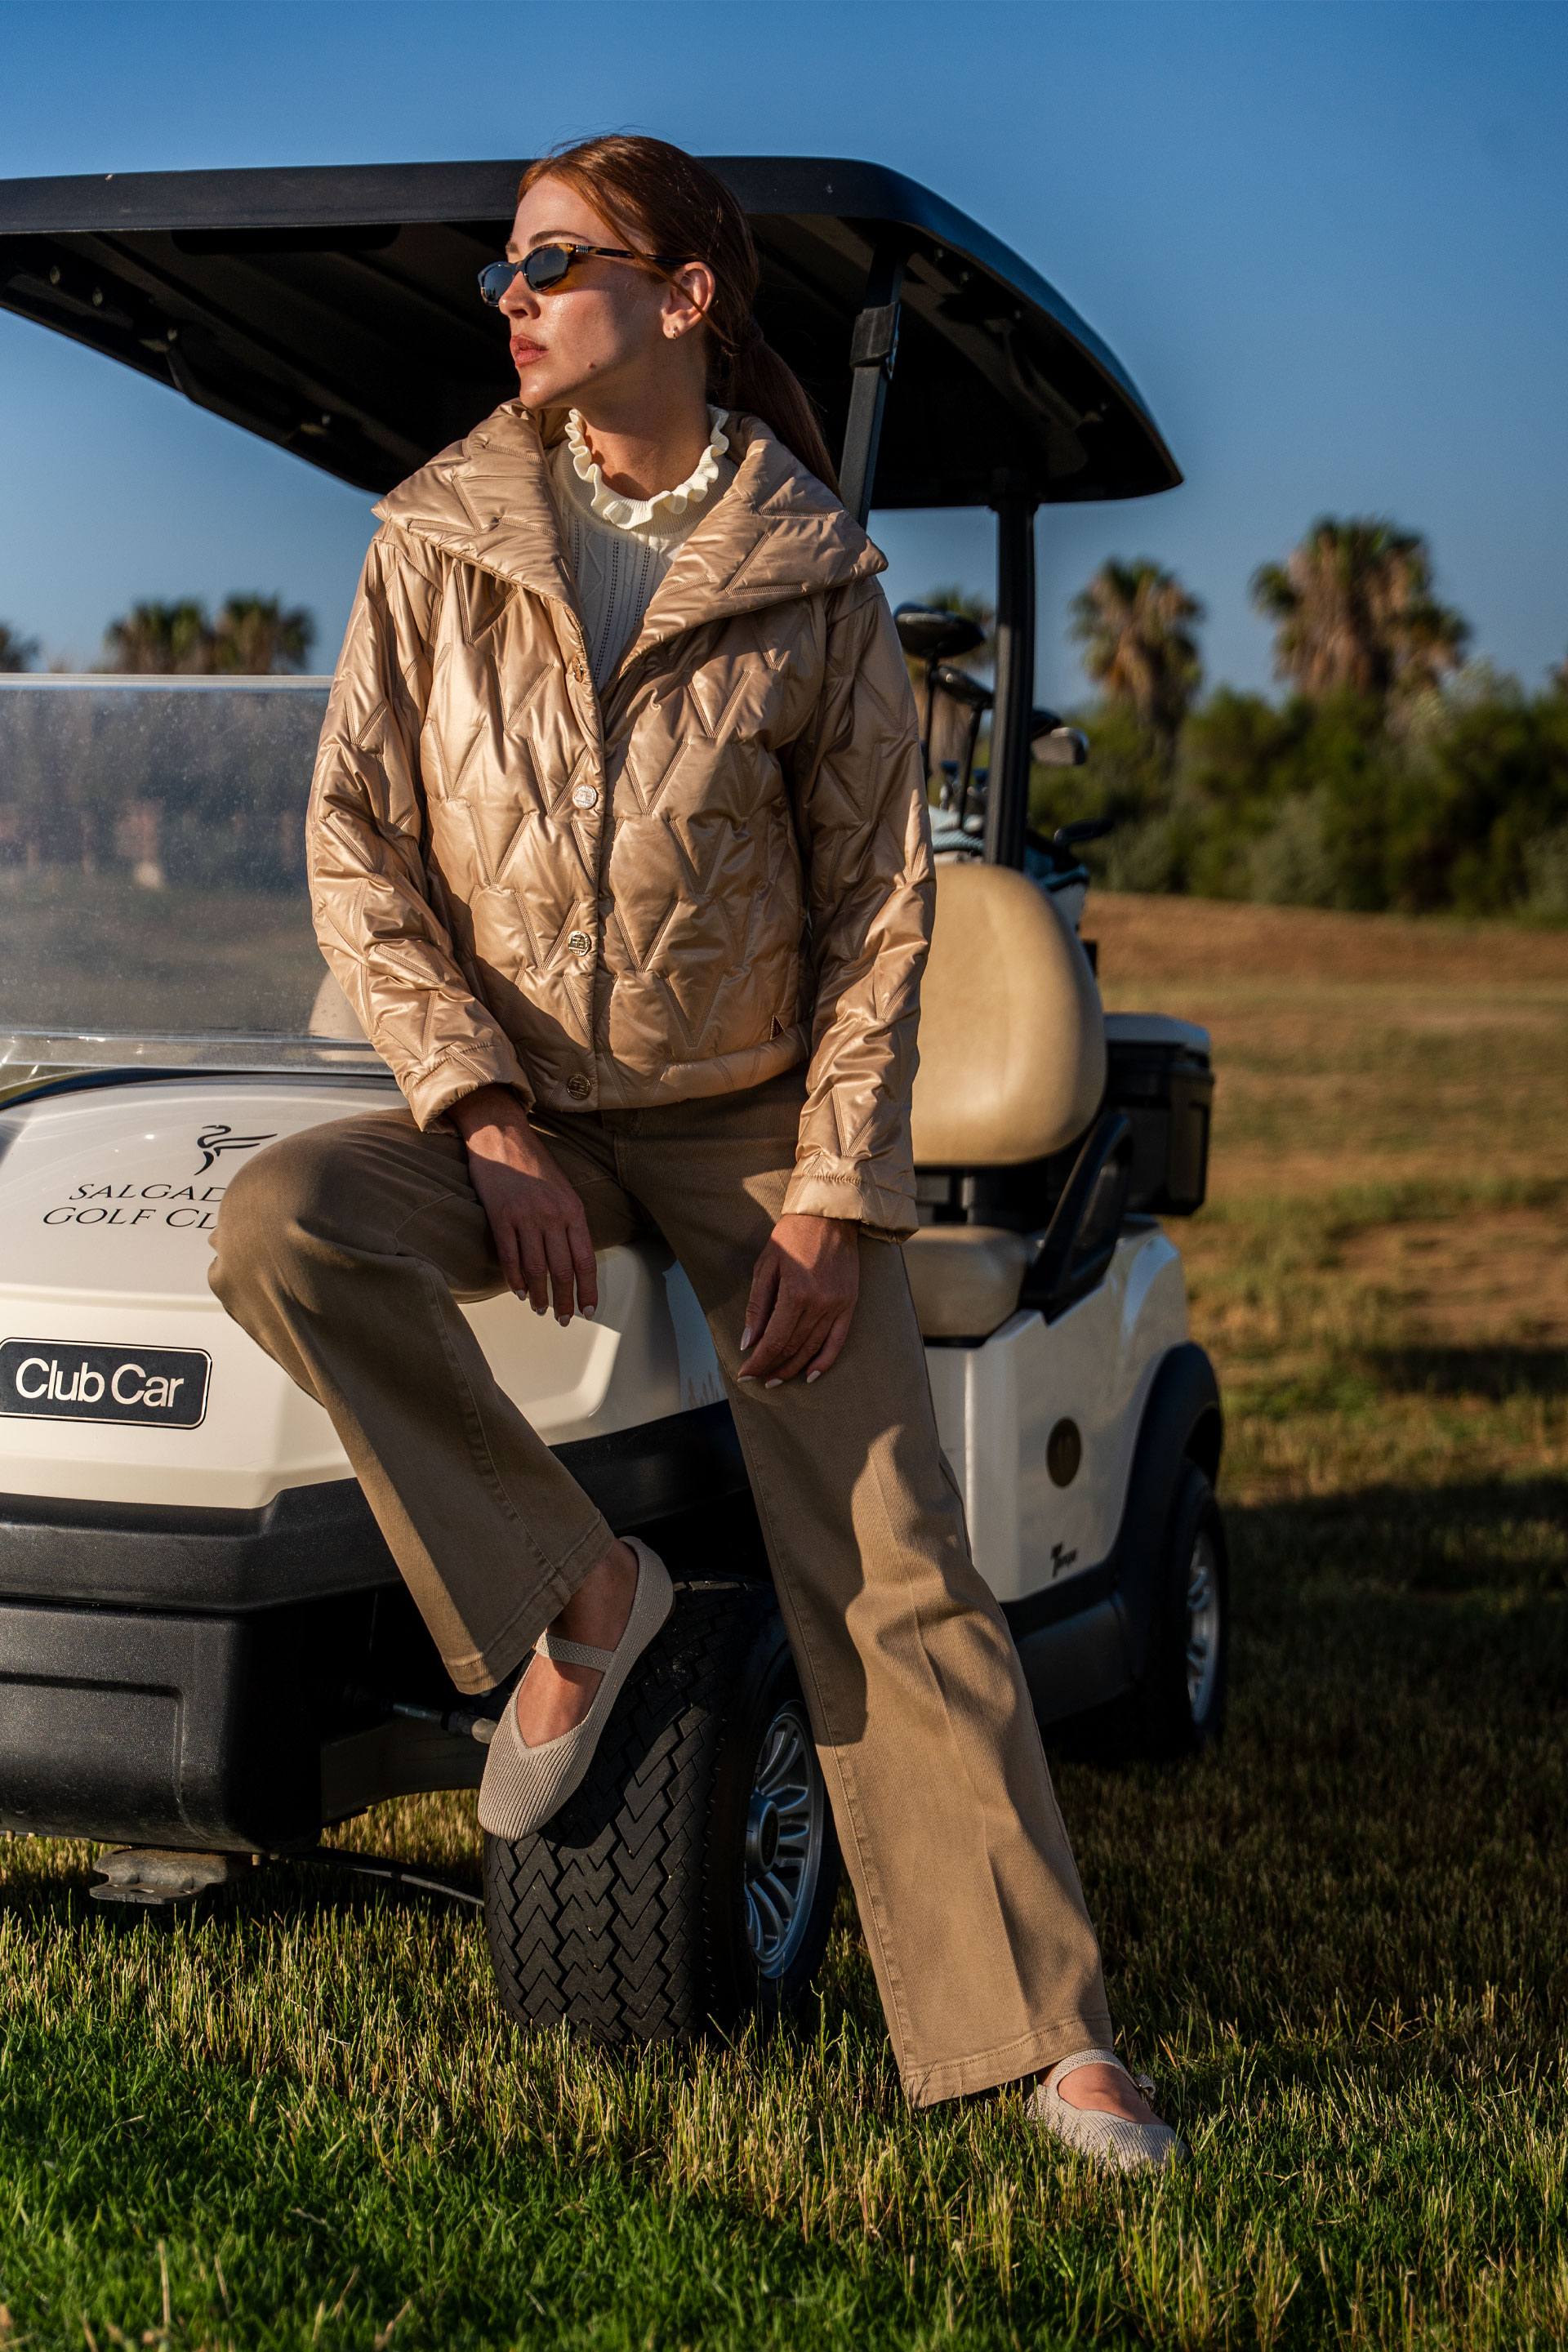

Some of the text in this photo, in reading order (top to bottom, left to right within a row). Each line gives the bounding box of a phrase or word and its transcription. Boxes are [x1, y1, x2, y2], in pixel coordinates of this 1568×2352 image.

[69, 1183, 226, 1202] SALGAD
[42, 1206, 218, 1230] GOLF CL
[15, 1357, 185, 1408] Club Car
